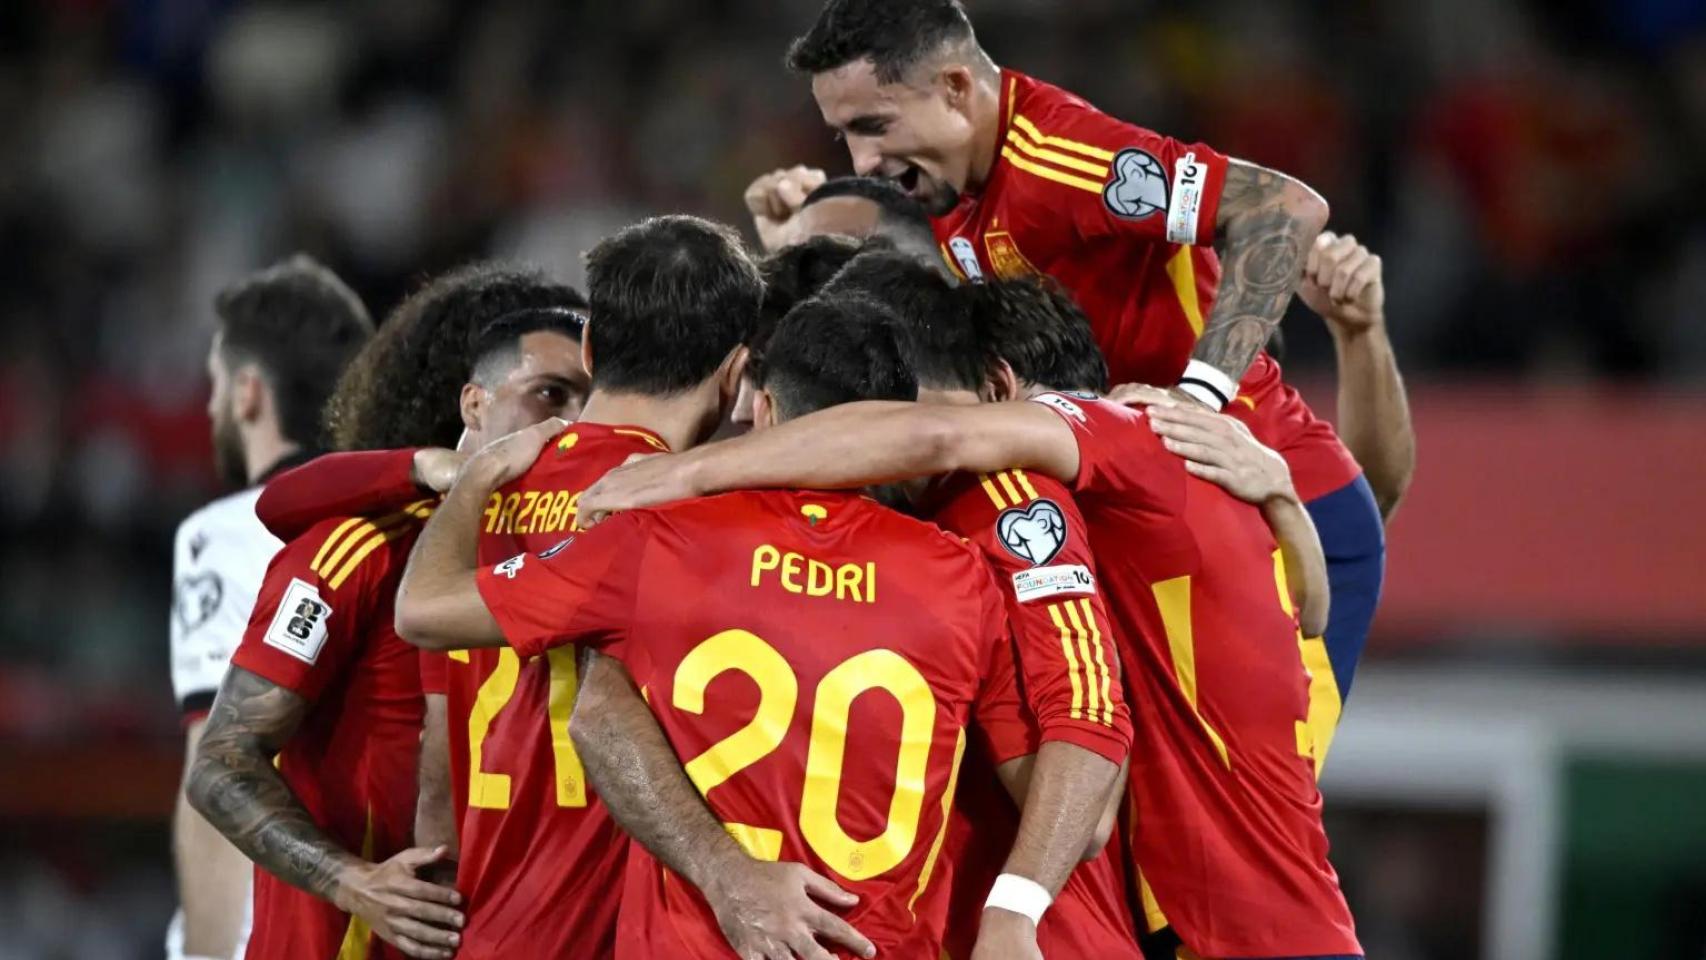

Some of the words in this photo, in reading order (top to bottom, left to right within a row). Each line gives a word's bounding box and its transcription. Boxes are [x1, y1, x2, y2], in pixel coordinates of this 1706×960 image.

[484, 490, 587, 534] ARZABA
[751, 544, 875, 603] PEDRI
[673, 629, 936, 880] 20
